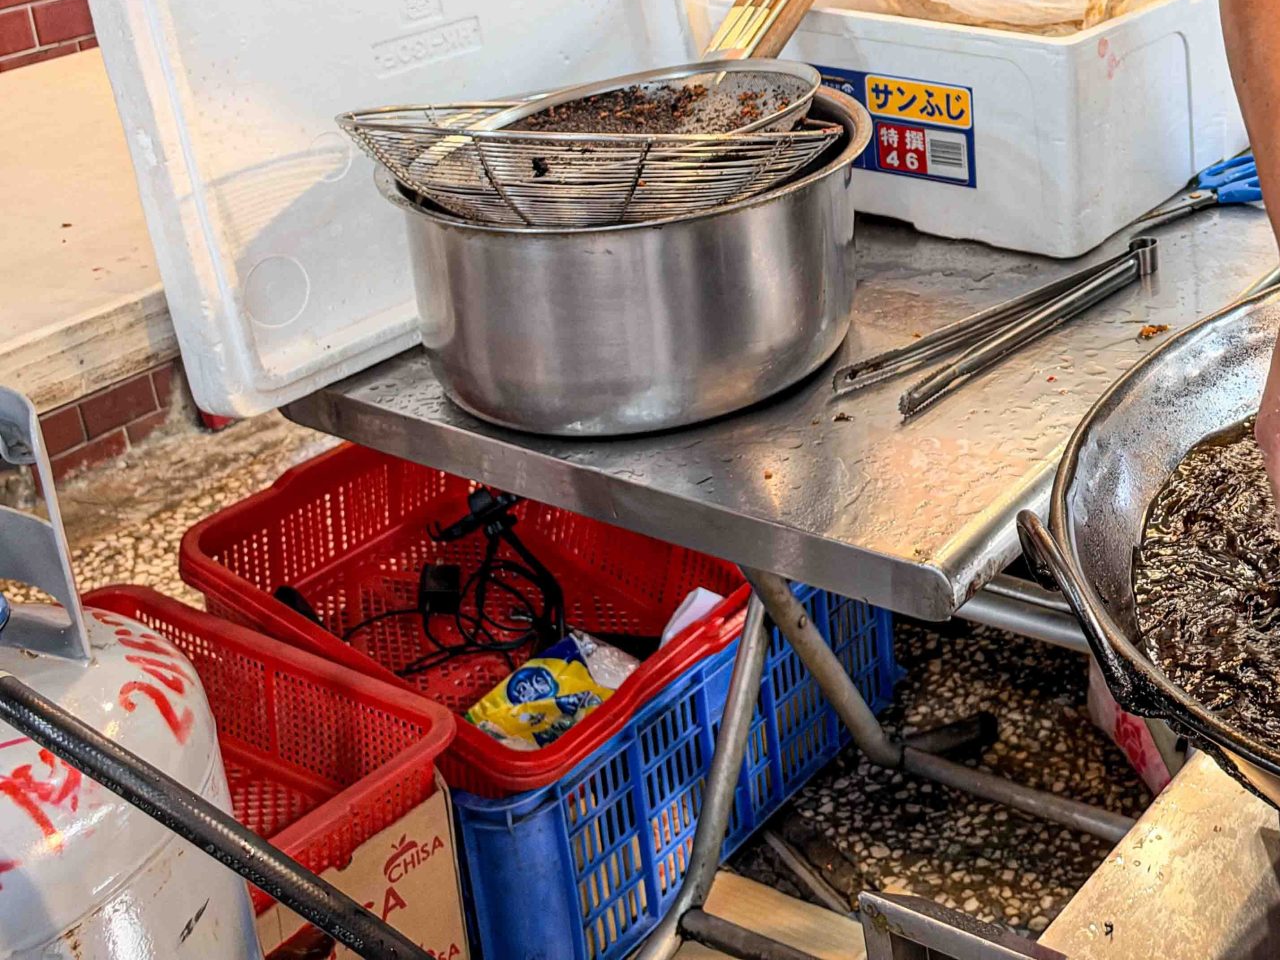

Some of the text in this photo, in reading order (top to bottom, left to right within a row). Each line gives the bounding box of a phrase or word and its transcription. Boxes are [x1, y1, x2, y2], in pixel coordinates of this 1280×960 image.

[871, 83, 966, 121] サンふじ
[886, 150, 919, 170] 46
[387, 835, 445, 884] CHISA
